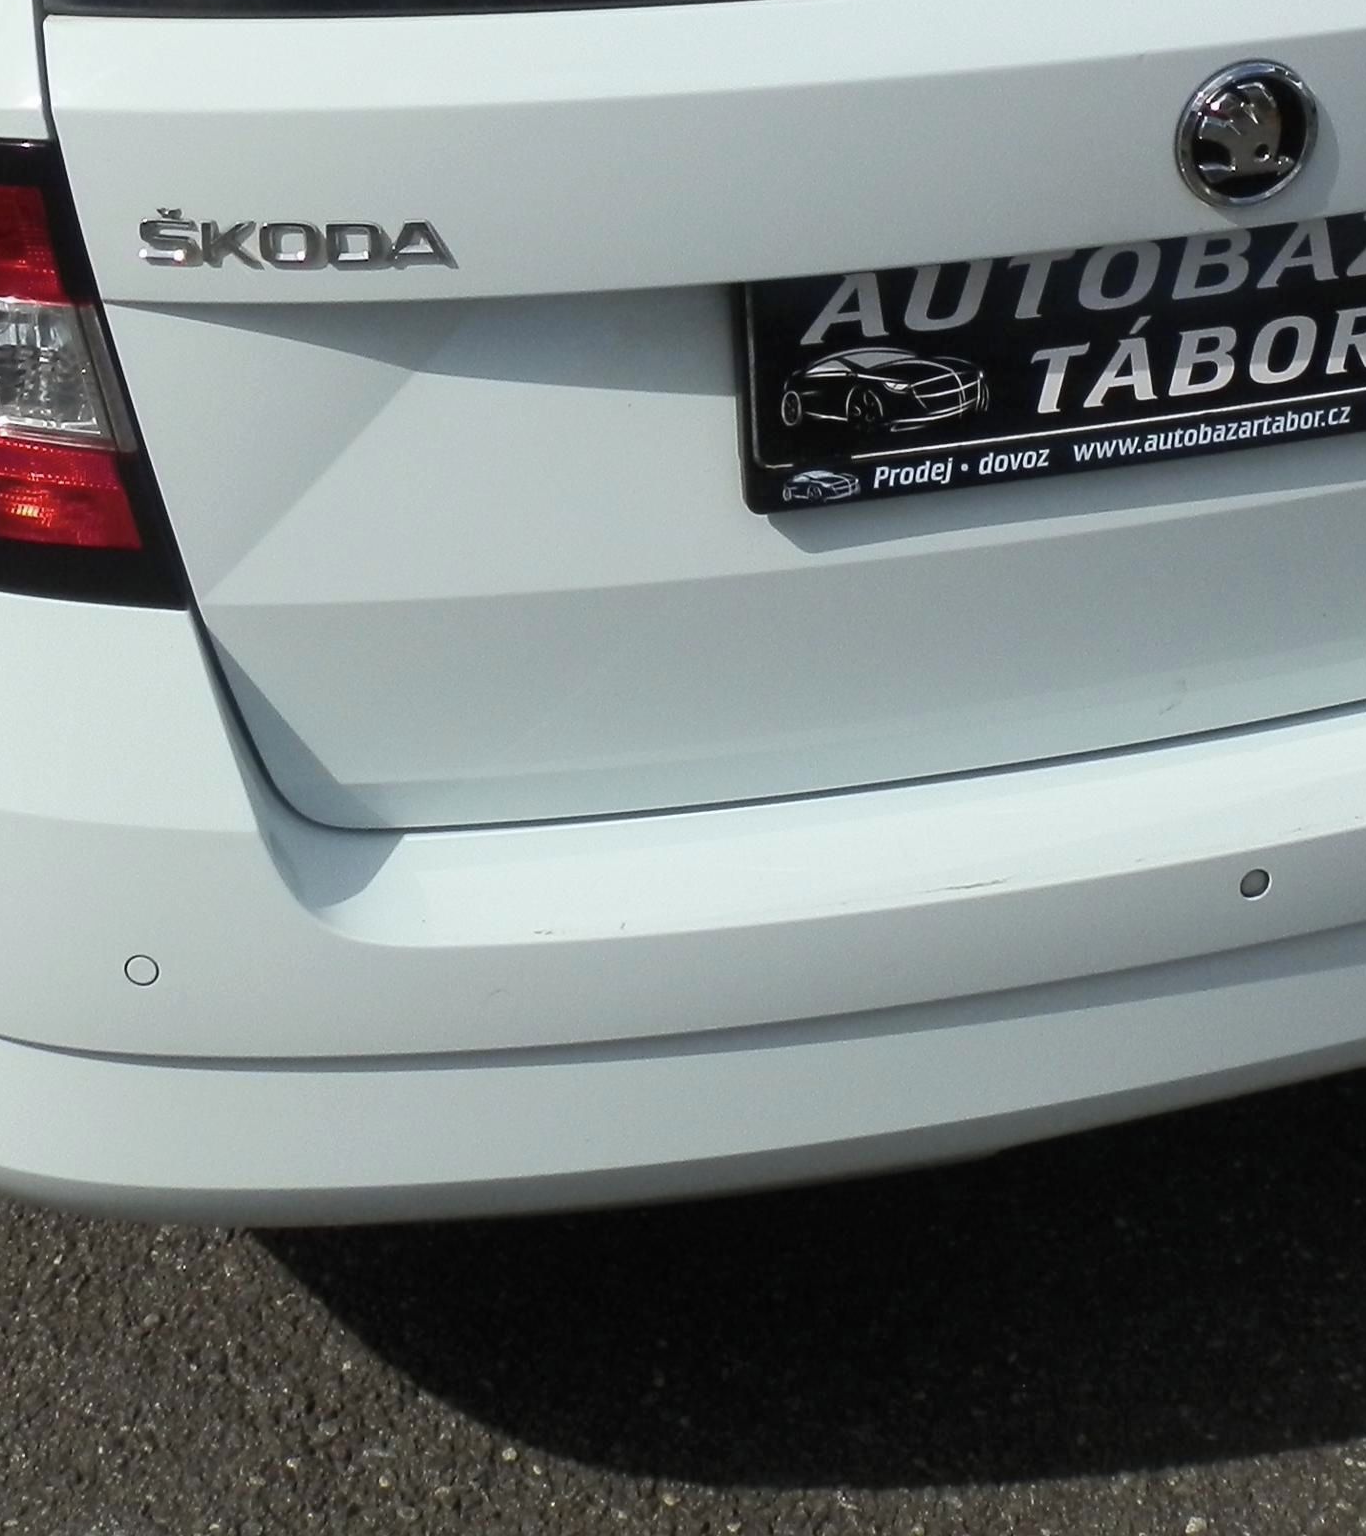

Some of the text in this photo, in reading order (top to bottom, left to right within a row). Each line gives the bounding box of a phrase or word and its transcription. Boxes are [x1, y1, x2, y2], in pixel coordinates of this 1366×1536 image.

[139, 207, 459, 270] ŠKODA
[873, 457, 953, 489] Prodej
[979, 447, 1050, 476] dovoz
[1073, 405, 1351, 462] www.autobazartabor.cz
